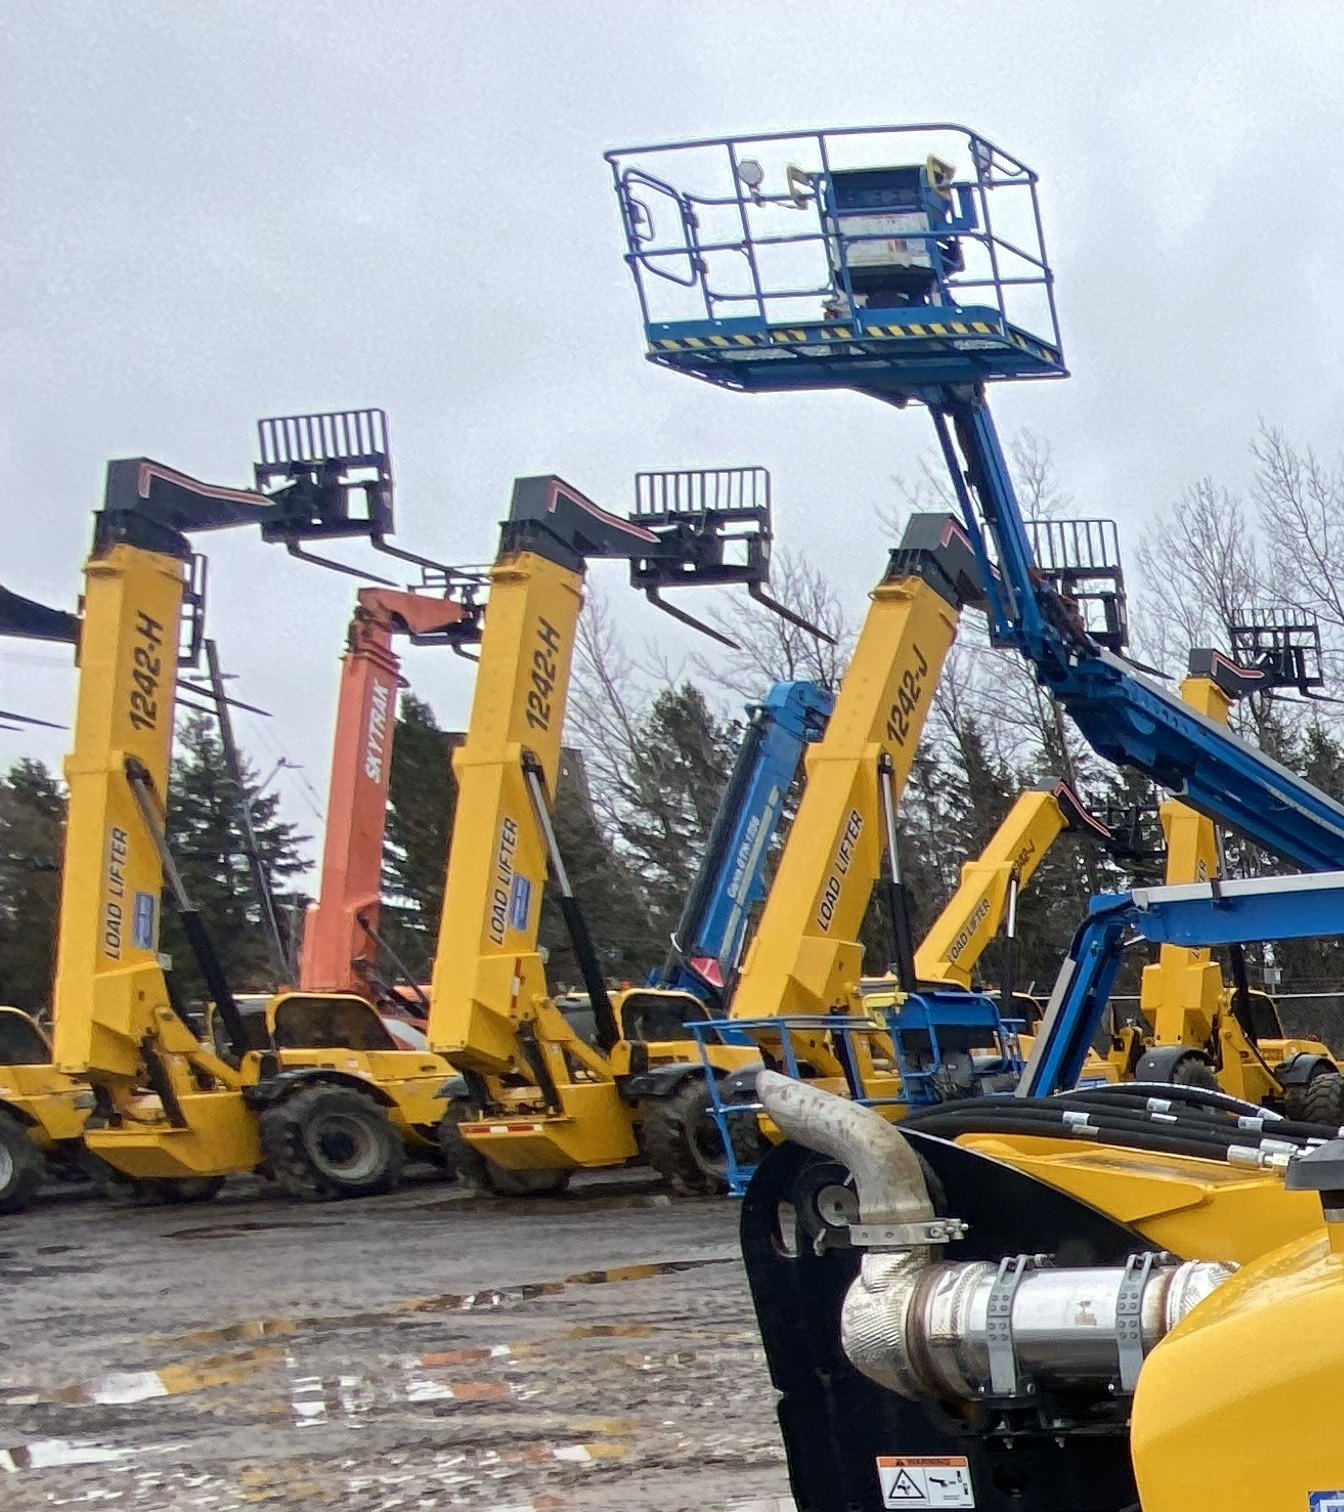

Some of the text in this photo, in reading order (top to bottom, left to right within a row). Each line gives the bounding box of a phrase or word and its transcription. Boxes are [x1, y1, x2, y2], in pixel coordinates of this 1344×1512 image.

[129, 609, 164, 731] 1242-H
[525, 615, 561, 732] 1242-H
[887, 641, 928, 747] 1242-J
[364, 677, 389, 785] SKYTRAK
[103, 826, 129, 961] LOAD LIFTER
[490, 816, 519, 946] LOAD LIFTER
[816, 808, 864, 933] LOAD LIFTER
[947, 898, 992, 963] LOAD LIFTER
